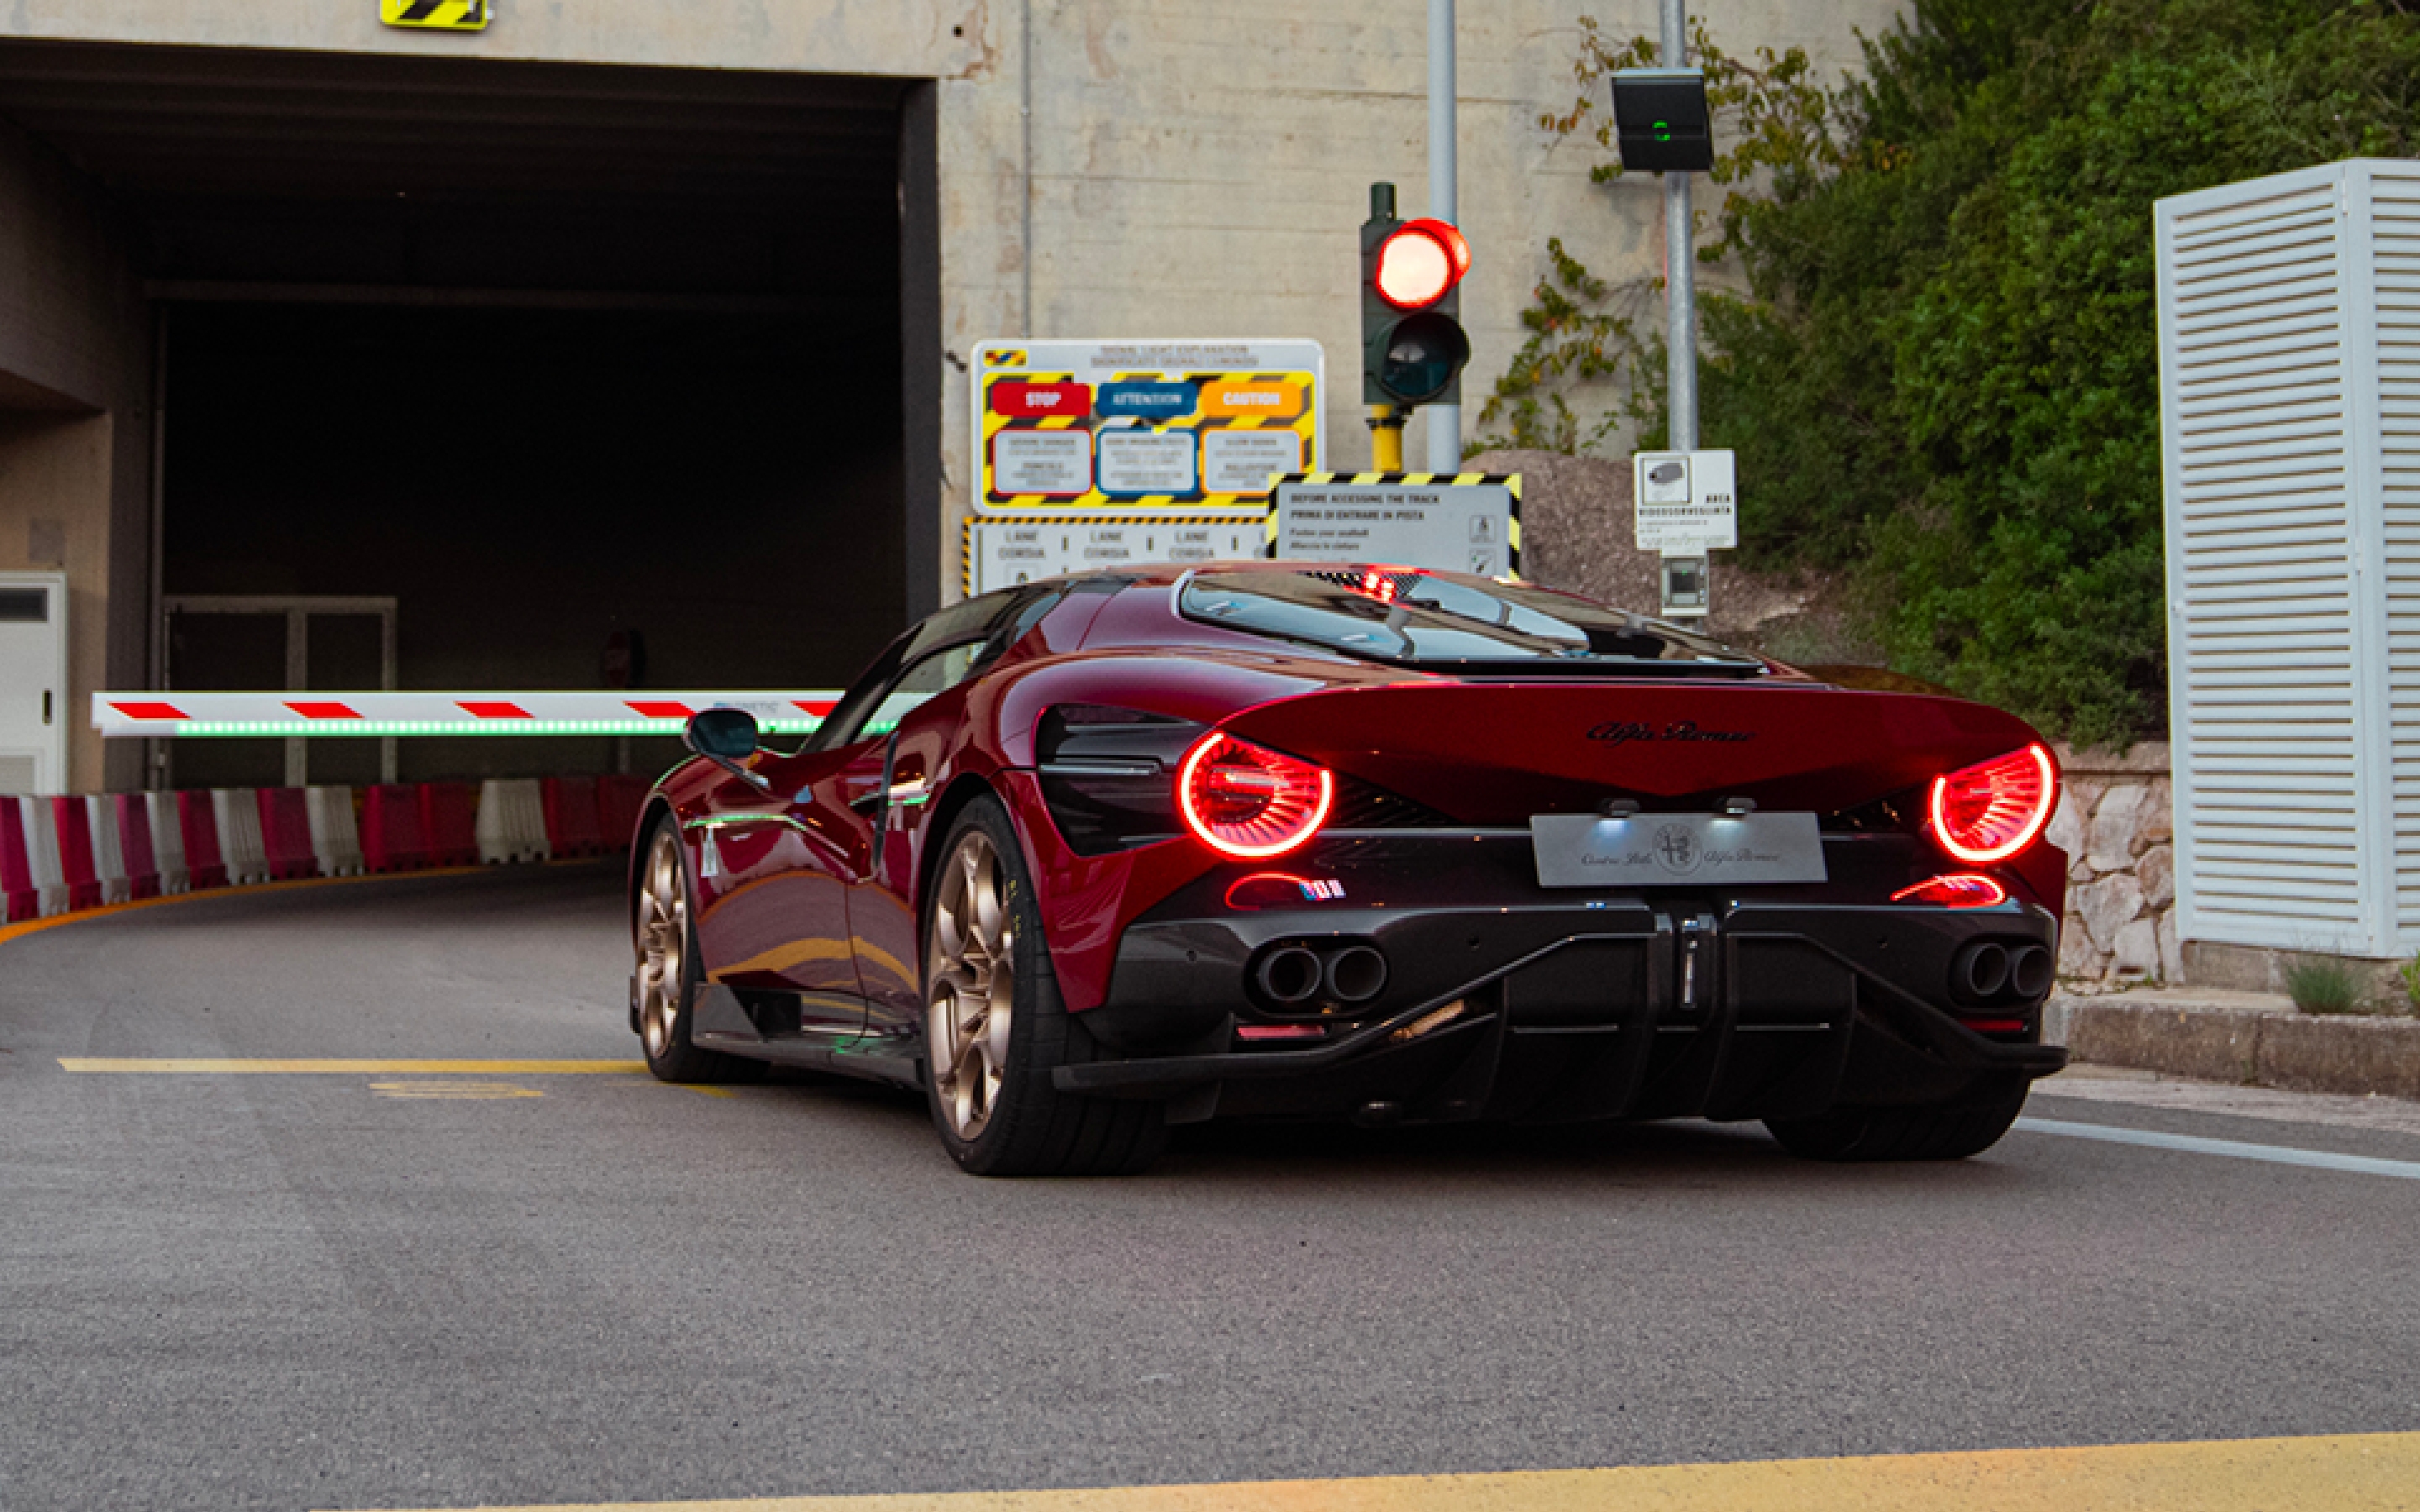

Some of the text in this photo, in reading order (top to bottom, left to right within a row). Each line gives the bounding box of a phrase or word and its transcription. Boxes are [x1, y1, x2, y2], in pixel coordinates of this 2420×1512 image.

[1026, 391, 1061, 407] STOP
[1113, 392, 1182, 406] ATTENTION
[1223, 391, 1281, 406] CAUTION
[1290, 493, 1439, 504] BEFORE ACCESSING THE TRACK
[1290, 510, 1424, 520] PRIMA DI ENTRARE IN PISTA
[1005, 530, 1038, 542] LANE
[1091, 530, 1123, 542] LANE
[1175, 530, 1207, 542] LANE
[998, 548, 1045, 559] CORSIA
[1084, 548, 1129, 559] CORSIA
[1169, 548, 1214, 559] CORSIA
[1586, 720, 1757, 748] Alfa Romeo
[1703, 848, 1781, 866] Alfa Romeo
